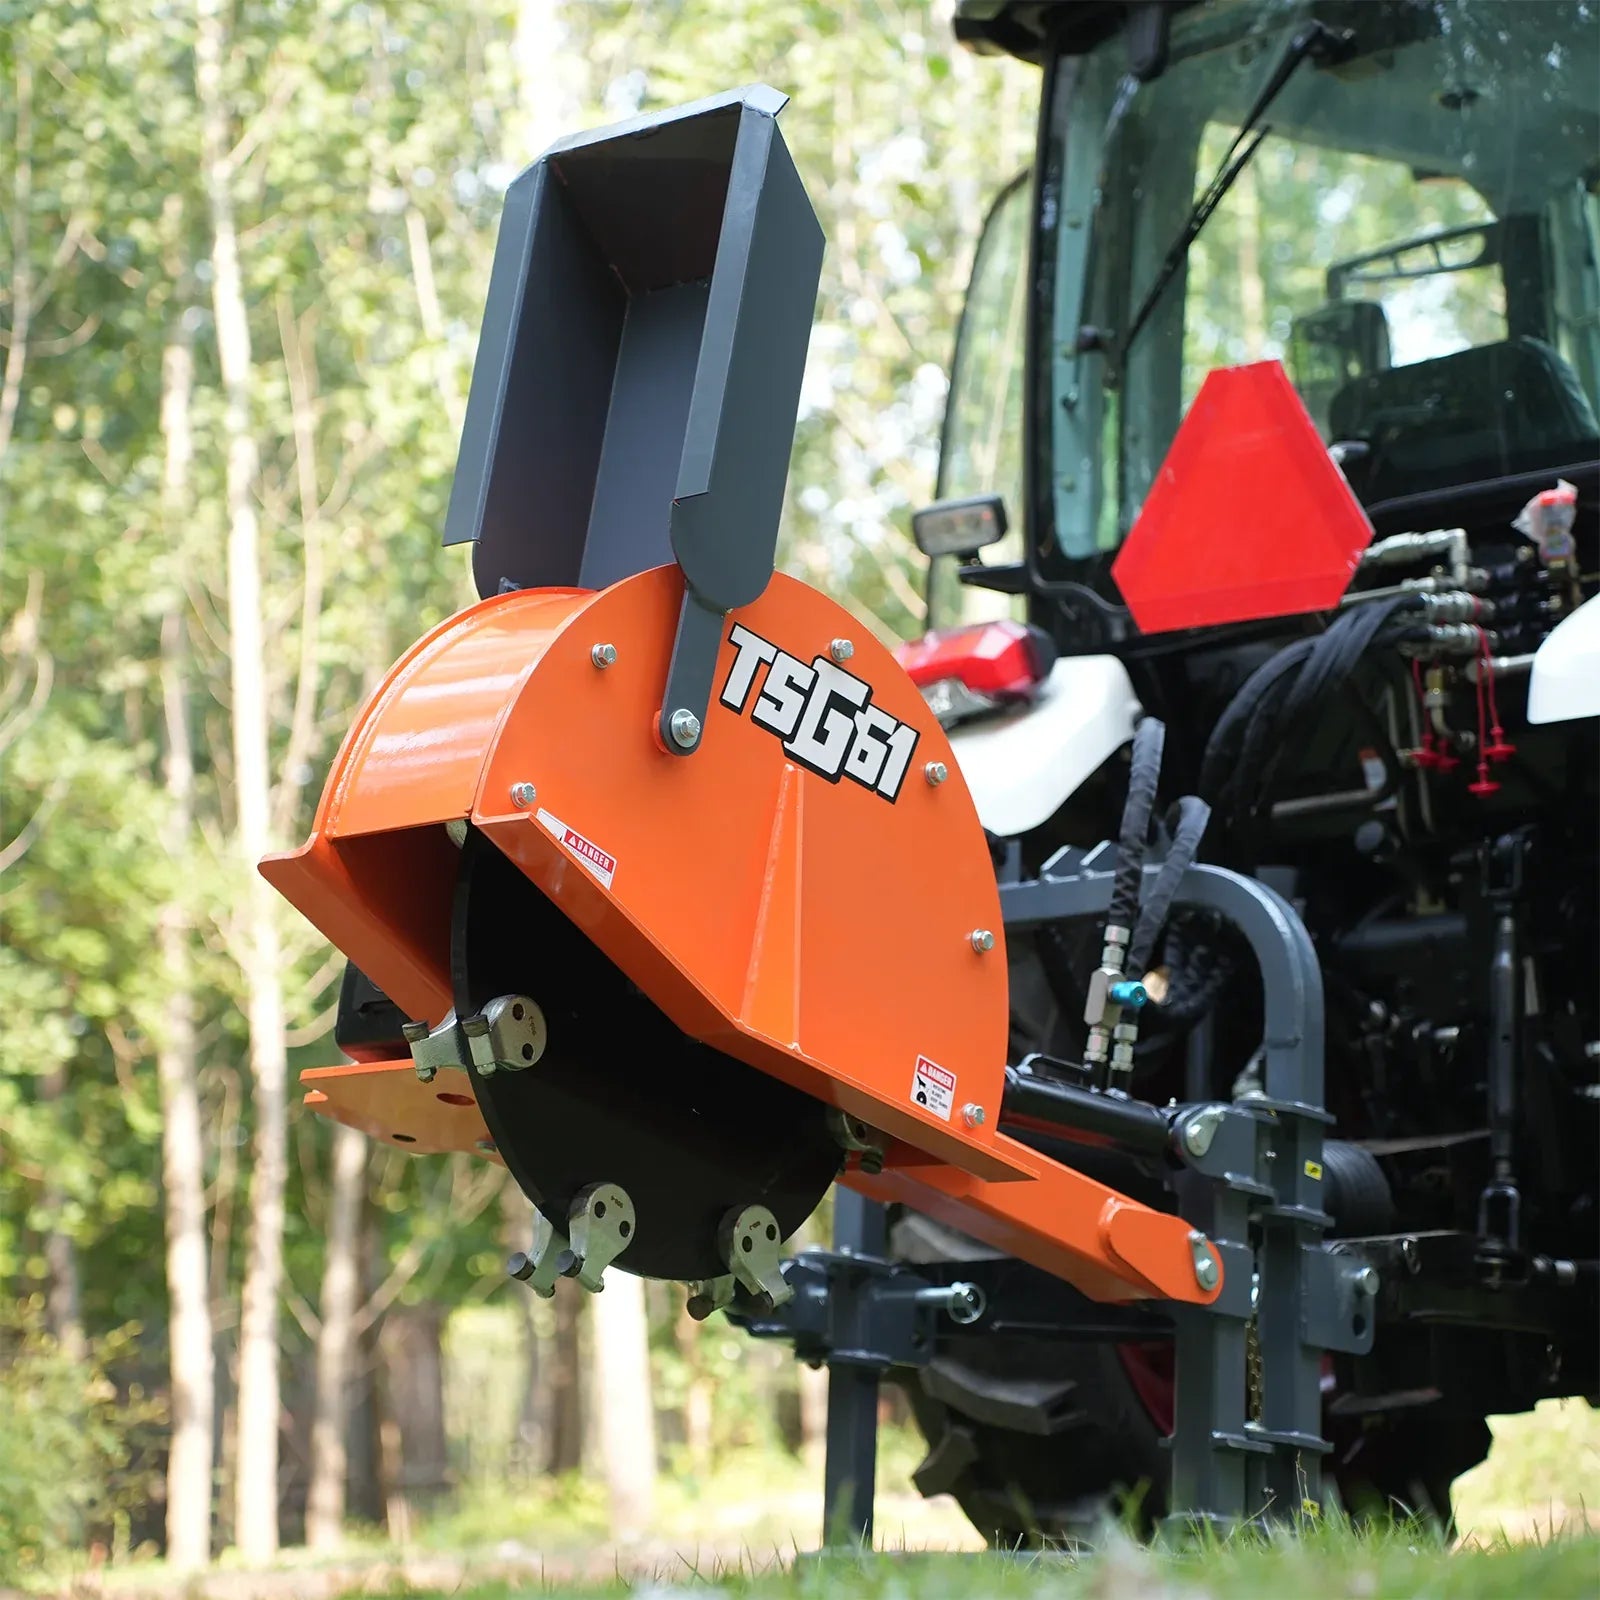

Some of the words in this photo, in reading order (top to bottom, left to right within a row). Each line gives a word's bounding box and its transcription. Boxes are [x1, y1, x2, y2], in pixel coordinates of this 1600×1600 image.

[720, 622, 920, 804] TSG61
[577, 839, 609, 869] DANGER
[928, 1065, 952, 1089] DANGER
